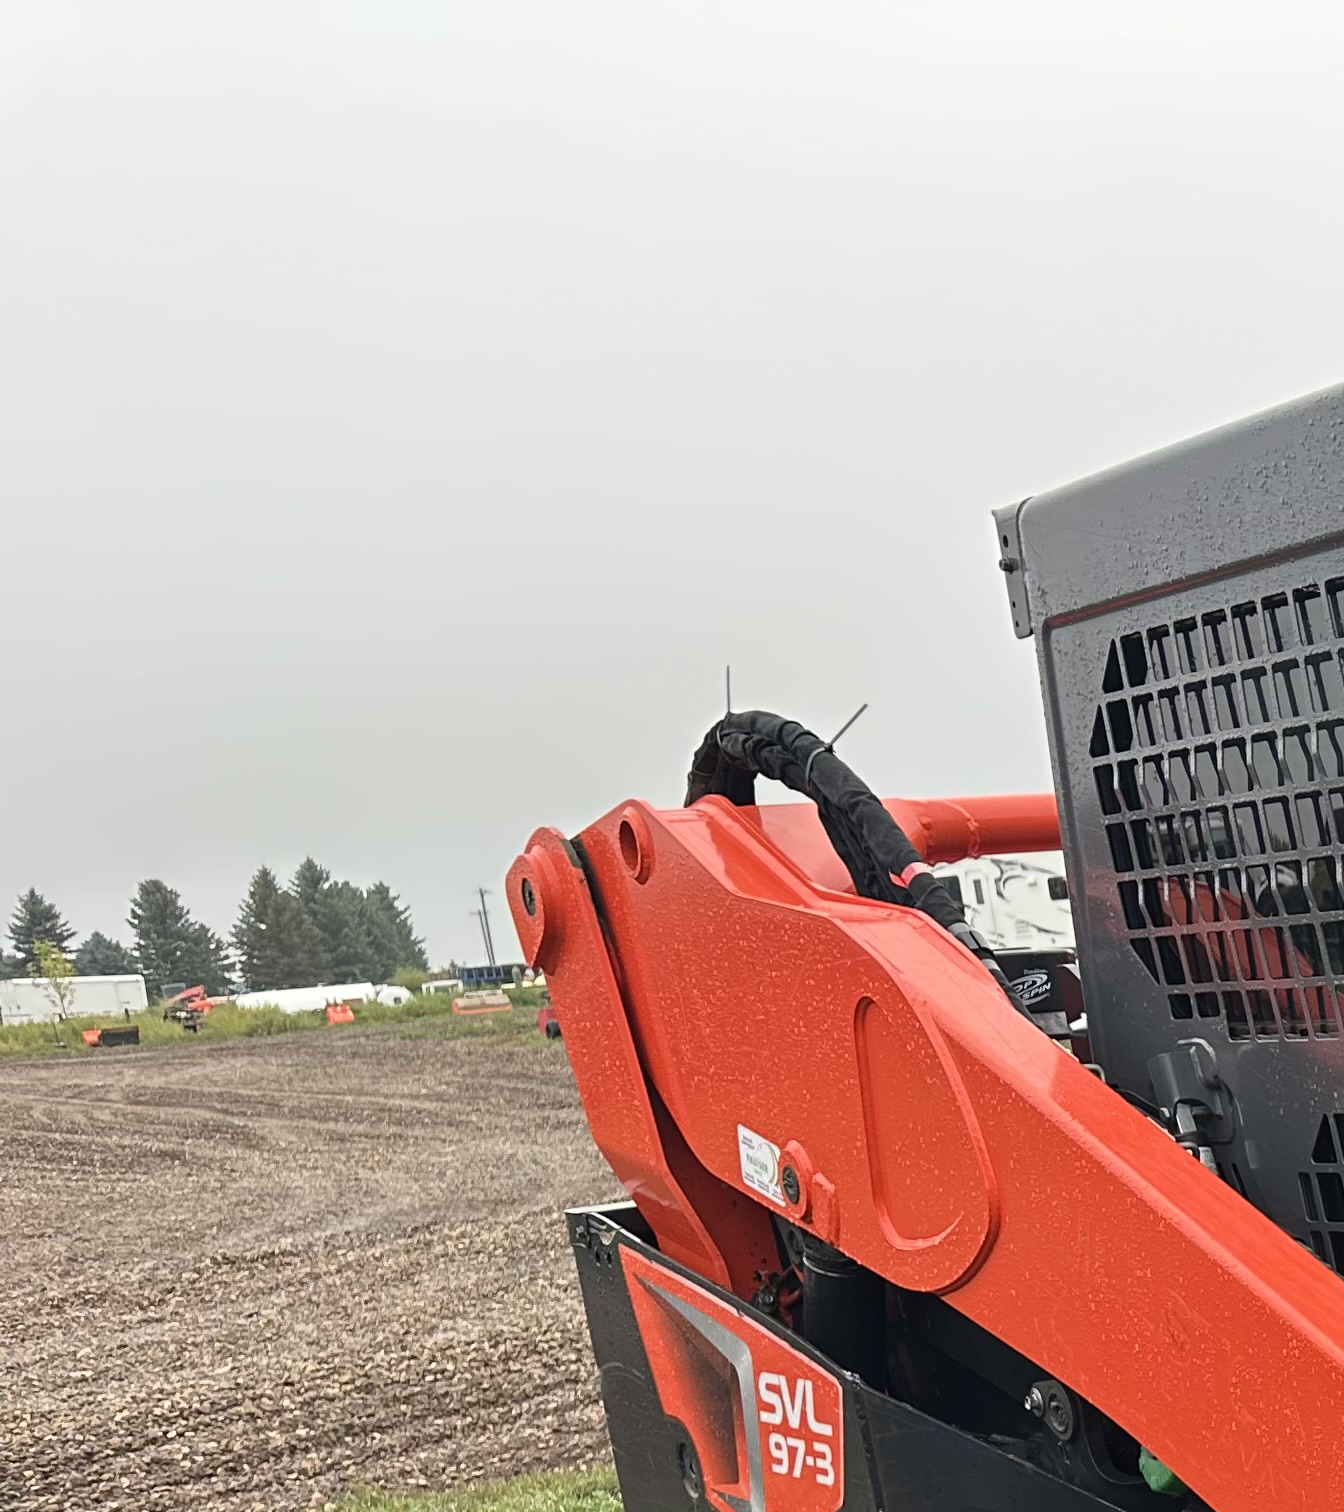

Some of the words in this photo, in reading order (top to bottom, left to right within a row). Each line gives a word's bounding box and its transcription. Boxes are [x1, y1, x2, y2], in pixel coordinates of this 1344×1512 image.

[1022, 981, 1052, 999] SPIN
[757, 1371, 833, 1437] SVL
[768, 1432, 836, 1487] 97-3
